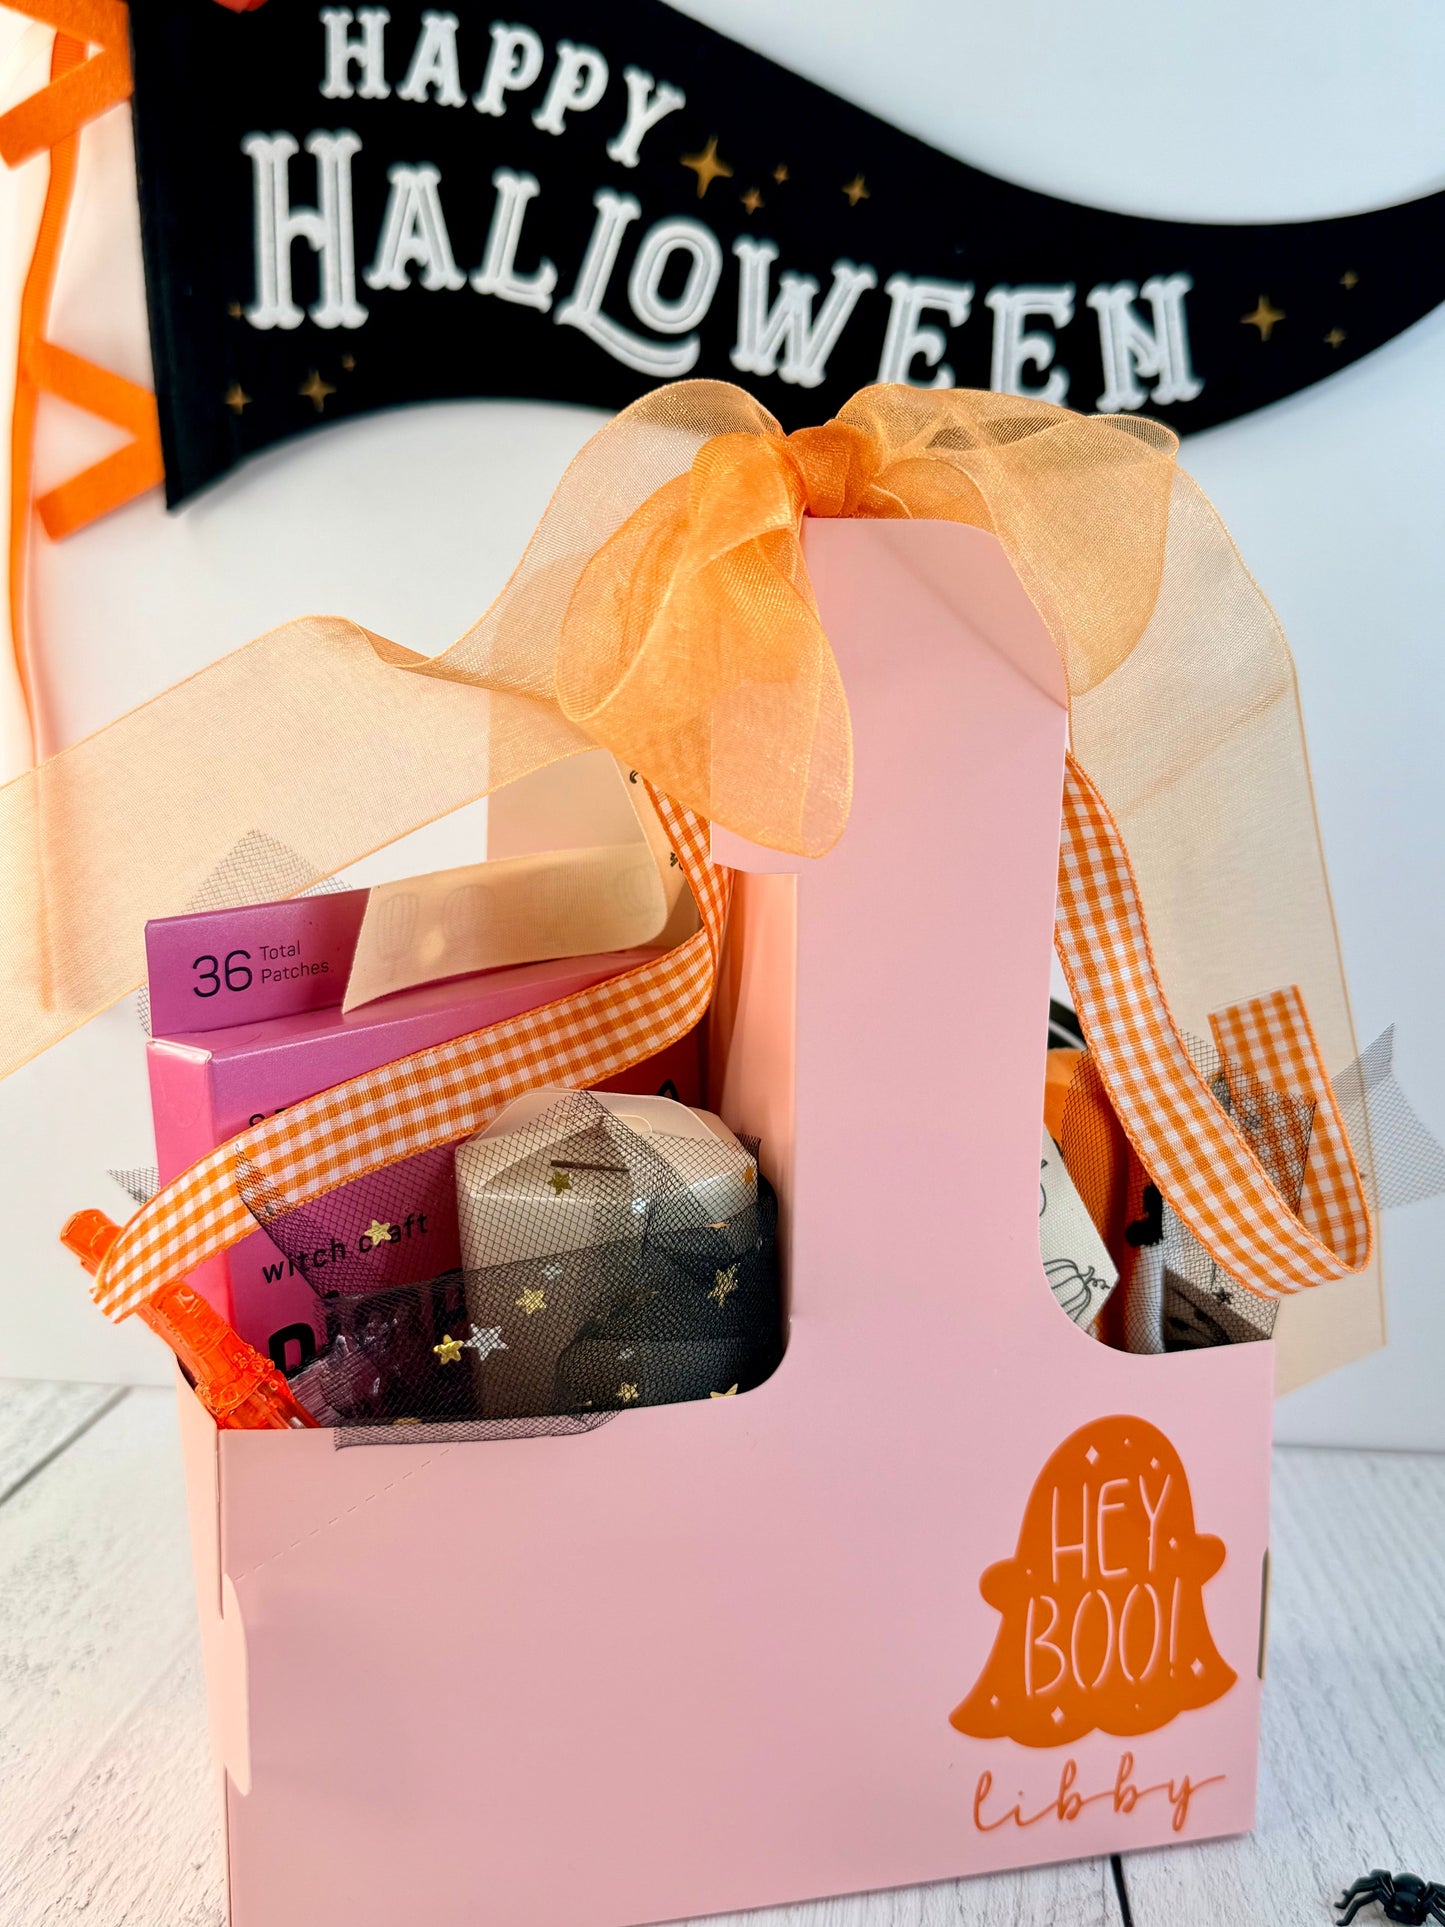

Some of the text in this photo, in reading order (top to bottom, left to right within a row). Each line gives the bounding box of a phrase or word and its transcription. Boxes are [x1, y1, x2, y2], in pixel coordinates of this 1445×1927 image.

[318, 6, 686, 168] HAPPY
[240, 129, 1203, 412] HALLOWEEN
[192, 940, 301, 998] 36 Total
[261, 959, 330, 984] Patches
[262, 1213, 428, 1284] witch caft
[1050, 1473, 1172, 1585] HEY
[1023, 1576, 1181, 1698] BOO!
[972, 1750, 1227, 1834] libby
